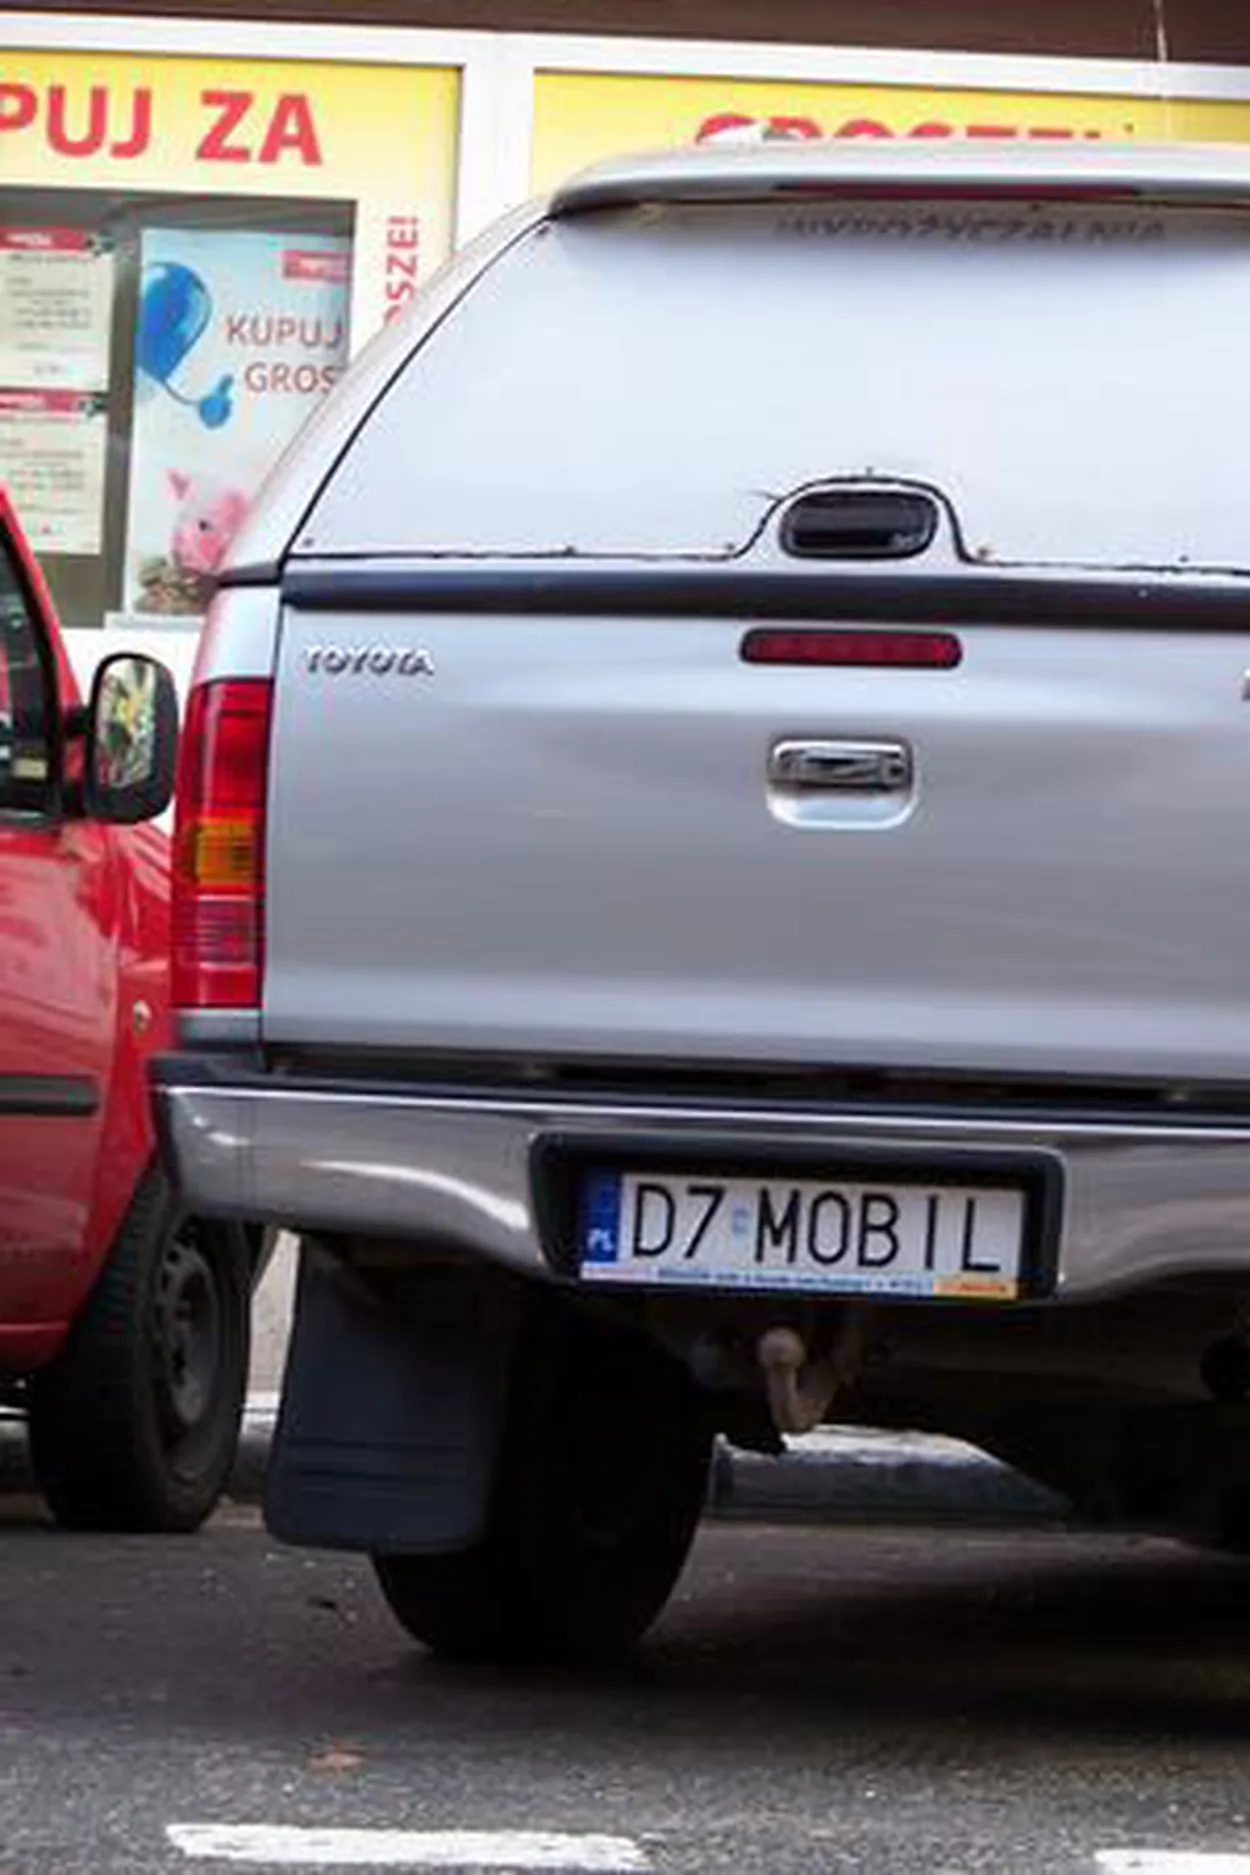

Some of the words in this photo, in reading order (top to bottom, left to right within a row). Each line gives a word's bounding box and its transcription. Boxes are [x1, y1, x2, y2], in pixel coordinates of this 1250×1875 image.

[0, 82, 151, 158] PUJ
[196, 90, 323, 166] ZA
[226, 315, 342, 348] KUPUJ
[306, 645, 434, 676] TOYOTA
[634, 1183, 726, 1259] D7
[754, 1188, 1000, 1272] MOBIL
